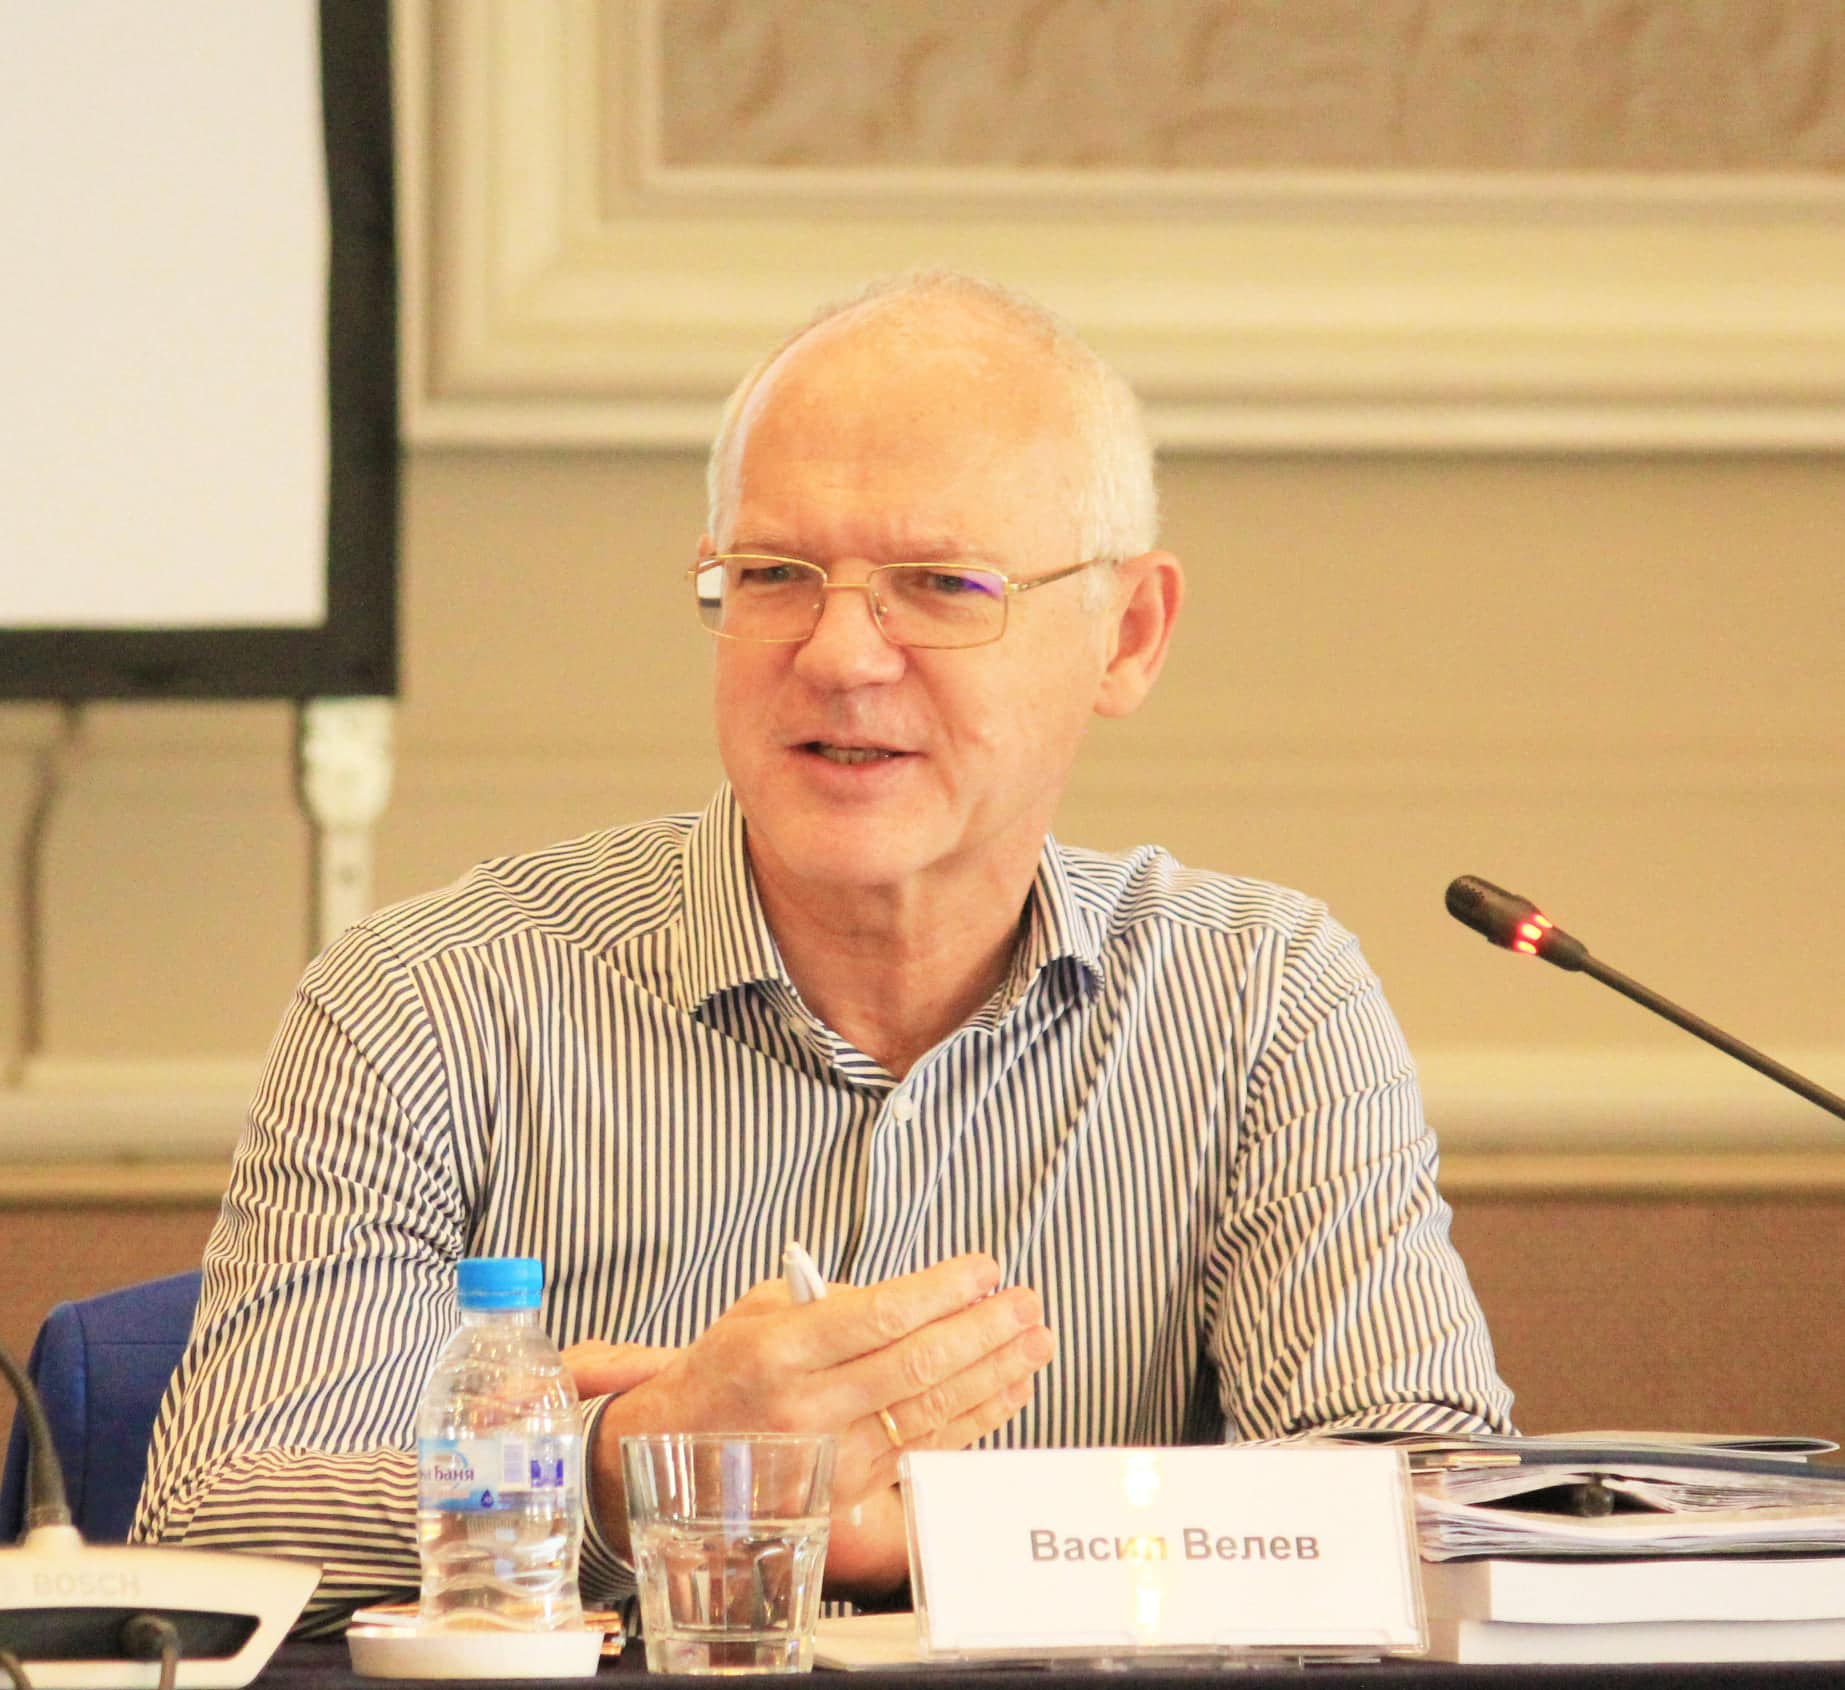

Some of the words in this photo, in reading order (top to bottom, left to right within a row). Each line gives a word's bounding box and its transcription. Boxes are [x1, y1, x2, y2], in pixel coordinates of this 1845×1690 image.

[1030, 1528, 1168, 1562] Васил
[1183, 1527, 1321, 1561] Велев
[32, 1571, 142, 1597] BOSCH
